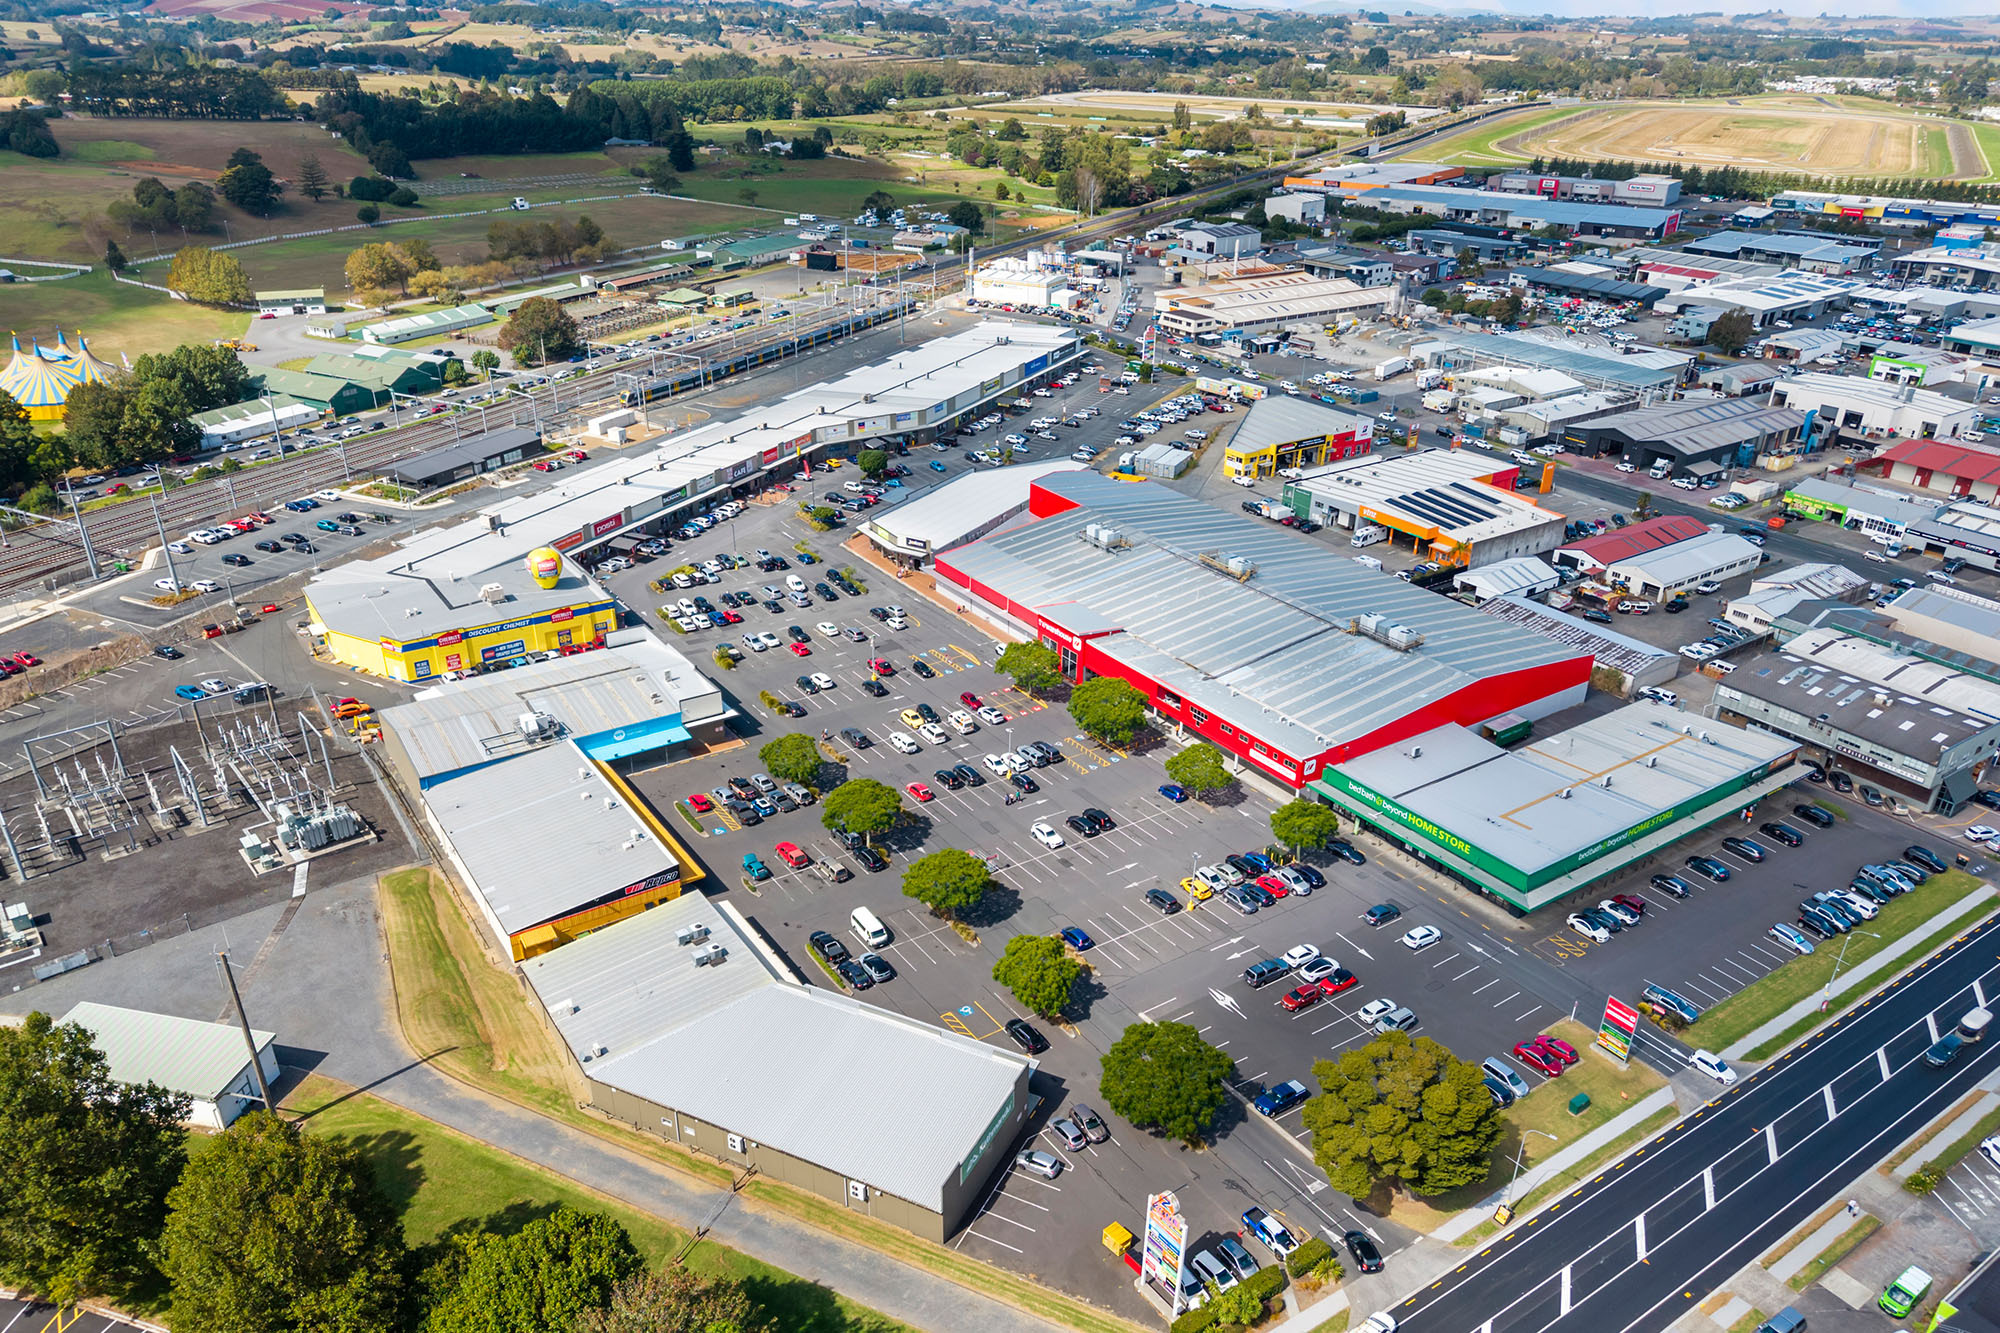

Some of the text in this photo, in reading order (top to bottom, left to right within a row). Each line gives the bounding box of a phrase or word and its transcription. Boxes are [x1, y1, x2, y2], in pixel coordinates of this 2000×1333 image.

[468, 620, 530, 637] DISCOUNT CHEMIST
[1348, 780, 1361, 794] bed
[1361, 788, 1377, 802] bath
[1382, 800, 1408, 819] beyond
[1407, 813, 1438, 837] HOME
[1438, 830, 1471, 855] STORE
[1628, 820, 1651, 837] HOME
[1650, 809, 1674, 826] STORE
[645, 871, 679, 888] Repco
